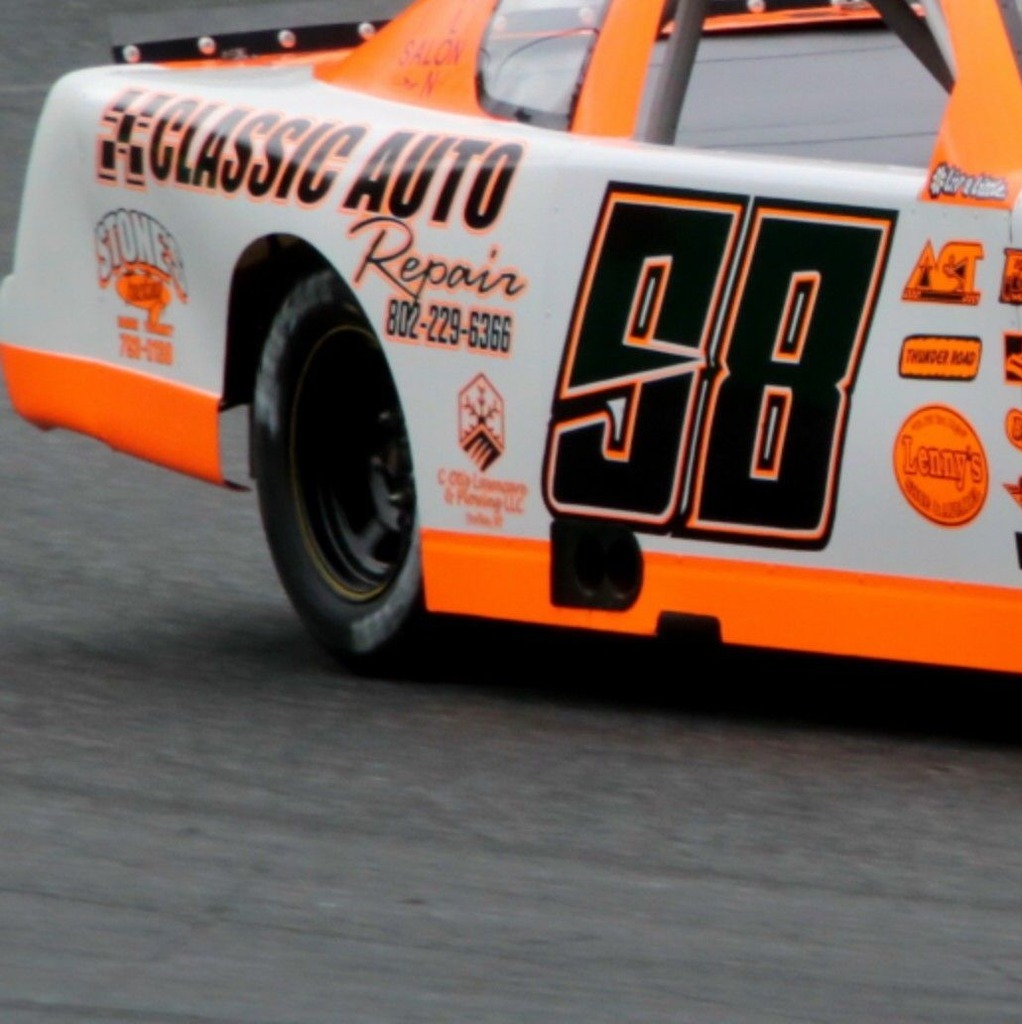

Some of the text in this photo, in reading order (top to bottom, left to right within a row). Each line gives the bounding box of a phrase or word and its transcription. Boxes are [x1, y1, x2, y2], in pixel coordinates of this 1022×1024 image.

[148, 94, 525, 230] CLASSIC AUTO
[348, 215, 526, 302] Repair
[386, 298, 512, 353] 802-229-6366
[541, 180, 899, 552] 98
[902, 434, 983, 492] Lenny's
